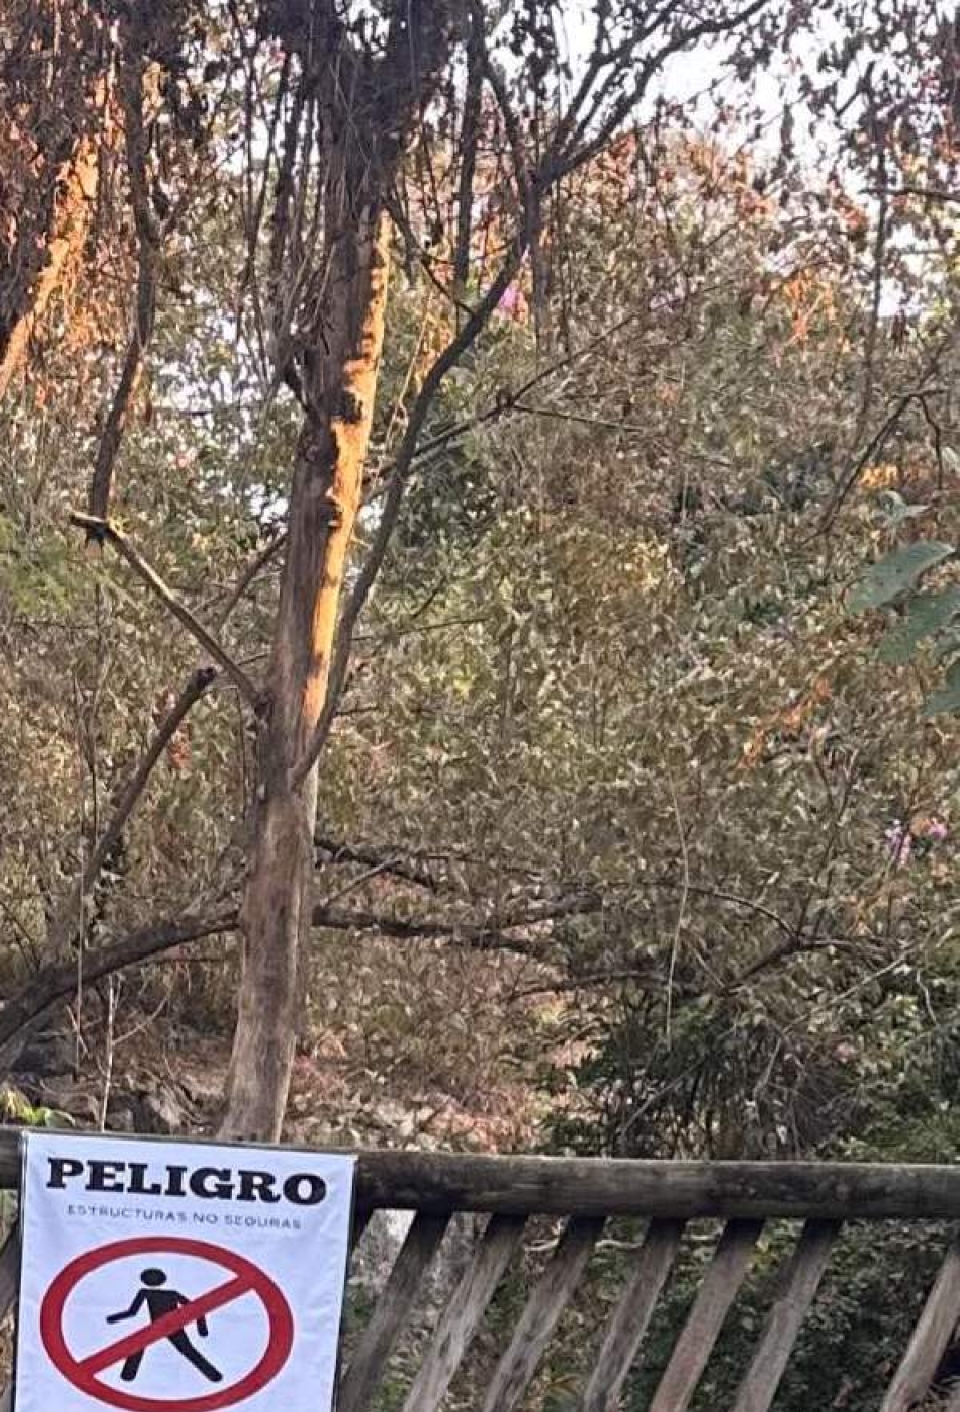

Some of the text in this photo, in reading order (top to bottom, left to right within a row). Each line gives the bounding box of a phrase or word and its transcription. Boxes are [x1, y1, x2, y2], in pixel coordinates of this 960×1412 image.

[46, 1157, 327, 1205] PELIGRO
[67, 1204, 302, 1230] ESTRUCTURAS NO SEGURAS
